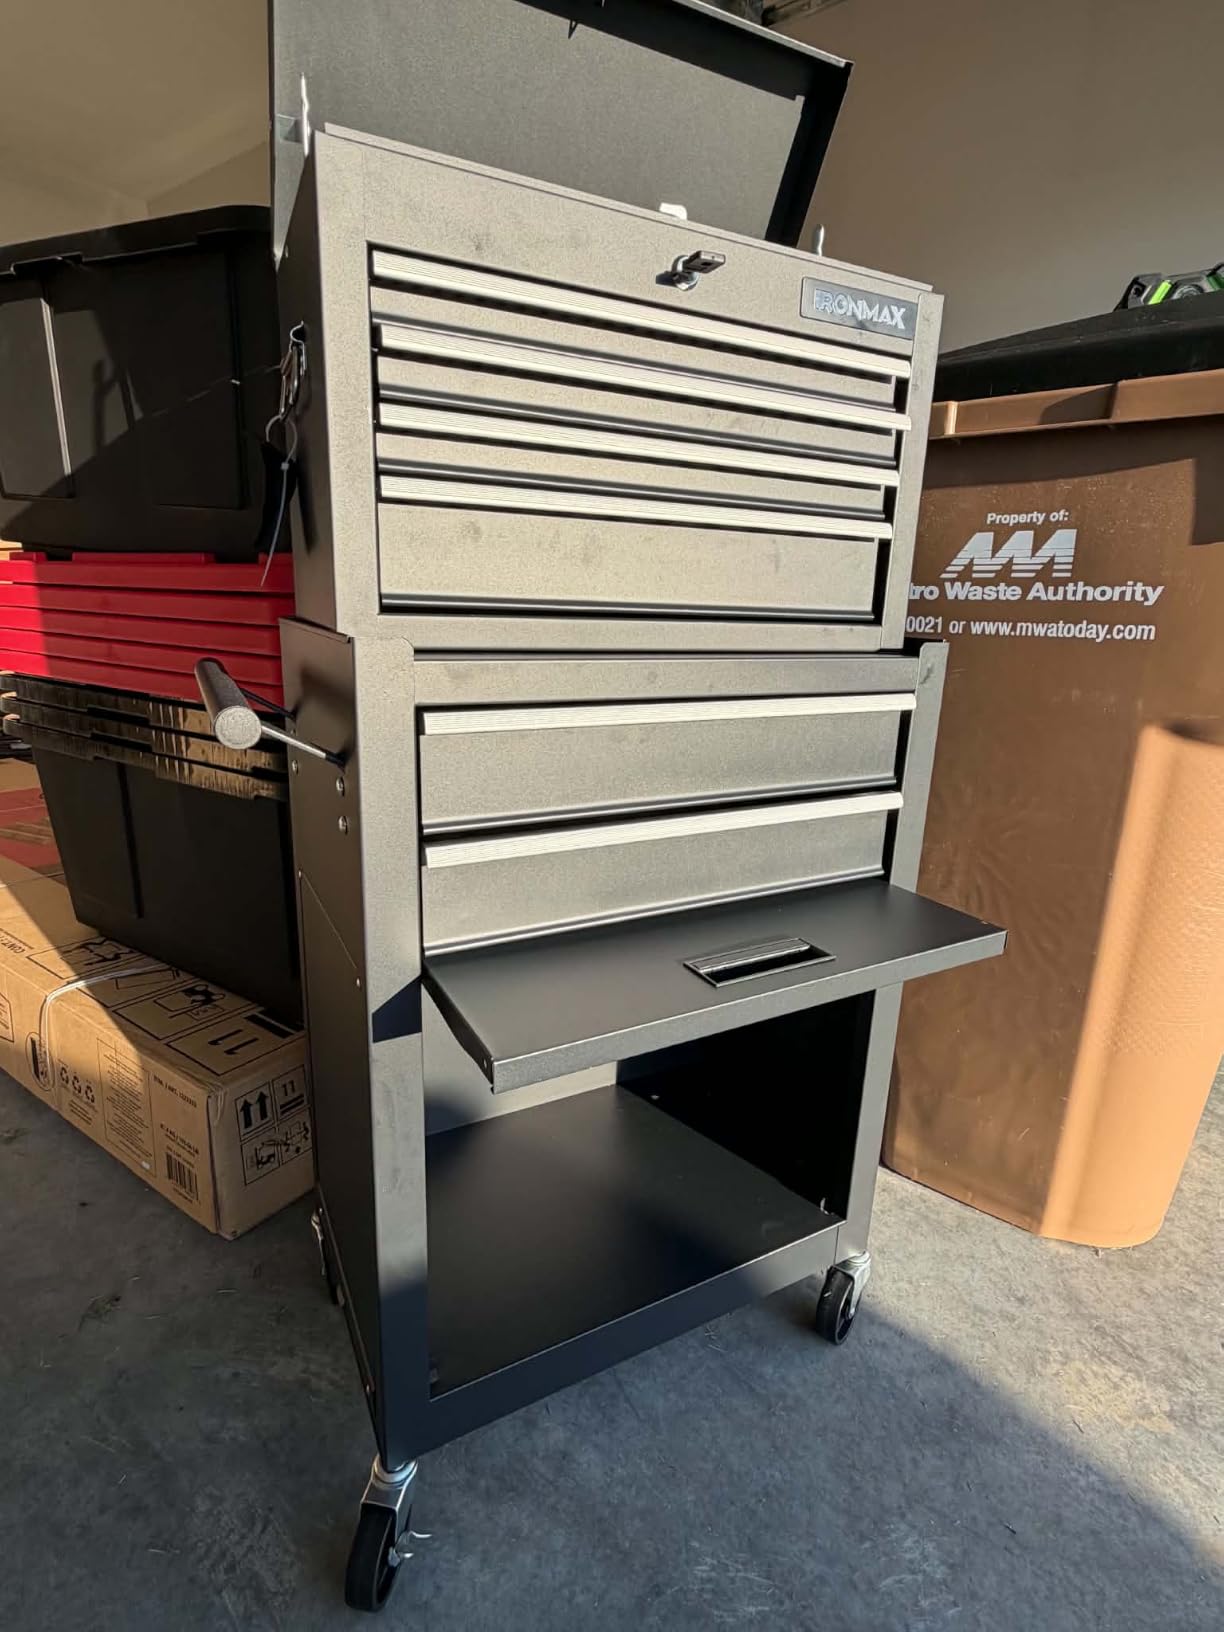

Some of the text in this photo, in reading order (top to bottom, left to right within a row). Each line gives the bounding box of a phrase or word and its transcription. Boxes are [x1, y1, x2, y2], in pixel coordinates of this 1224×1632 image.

[986, 509, 1069, 526] Property of:
[944, 581, 1022, 600] Waste
[1025, 580, 1165, 606] Authority
[948, 620, 966, 634] or
[970, 619, 1156, 643] www.mwatoday.com
